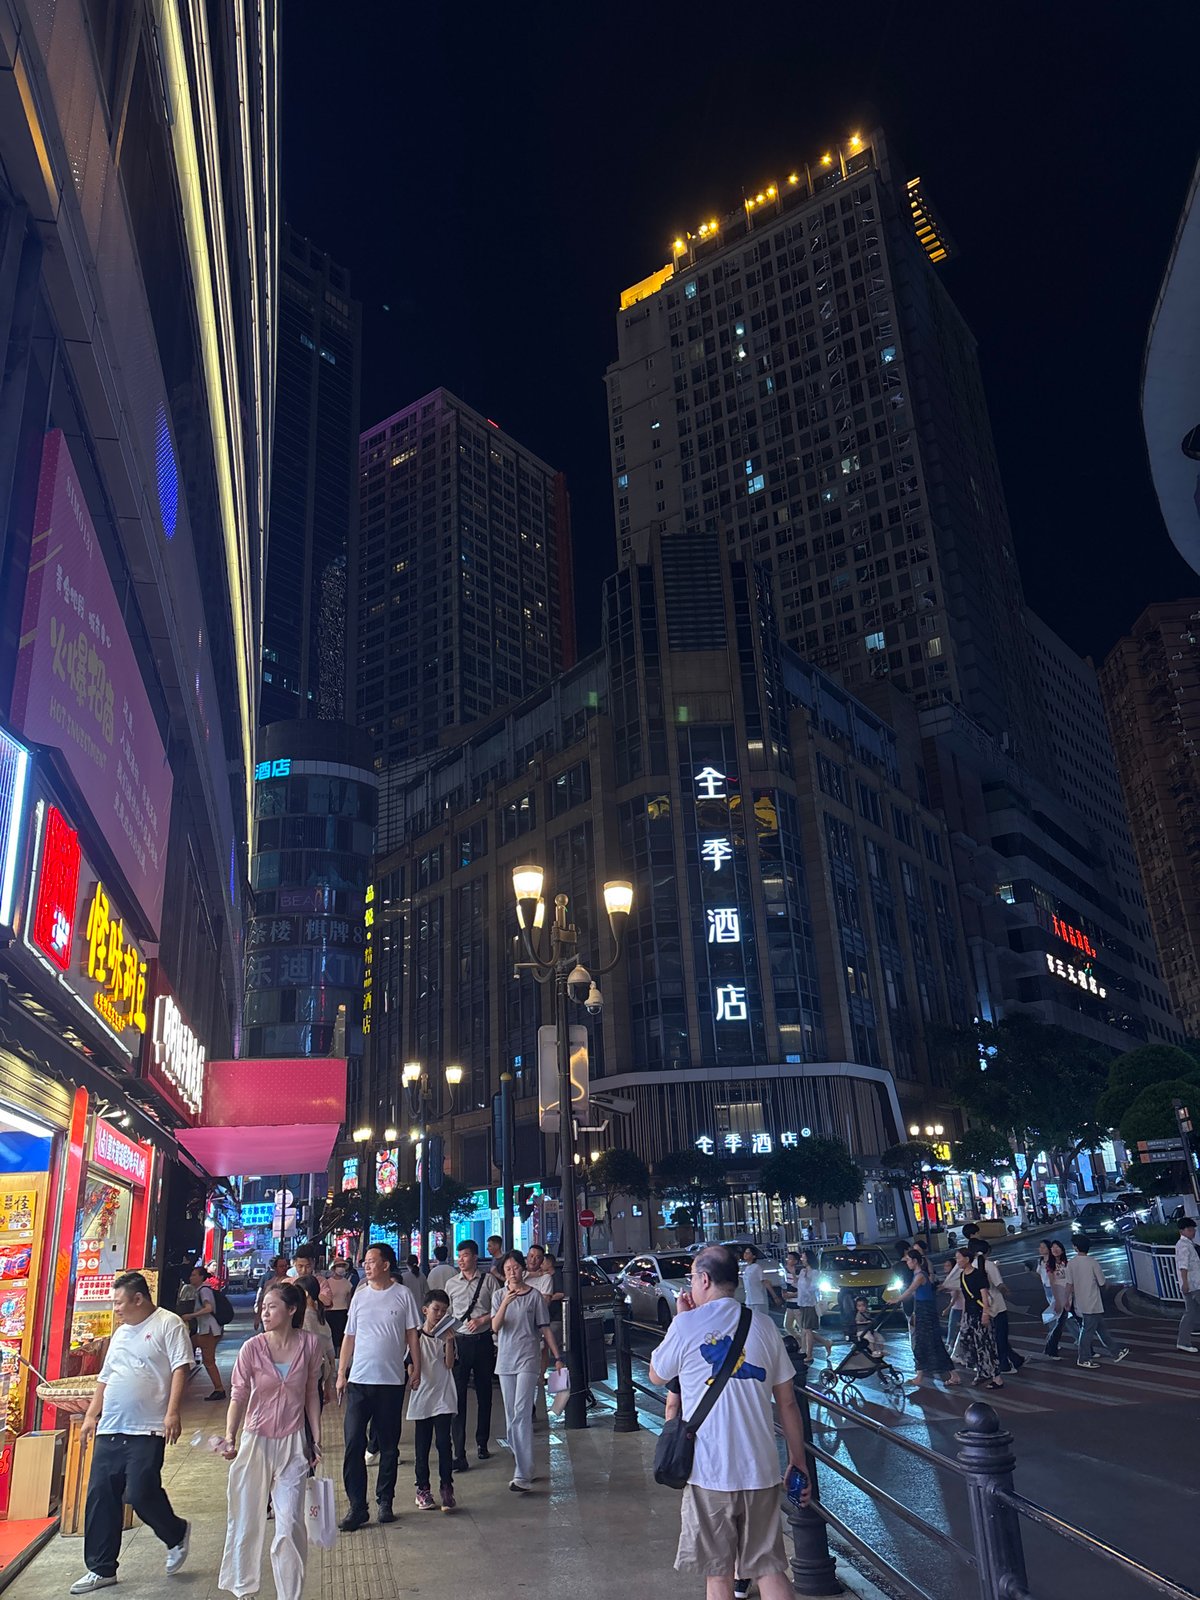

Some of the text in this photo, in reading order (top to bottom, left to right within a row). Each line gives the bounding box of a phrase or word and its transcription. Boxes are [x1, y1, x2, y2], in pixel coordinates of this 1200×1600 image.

[254, 758, 292, 782] 酒店
[87, 881, 146, 1034] 怪味胡豆
[694, 766, 747, 1021] 全季酒店
